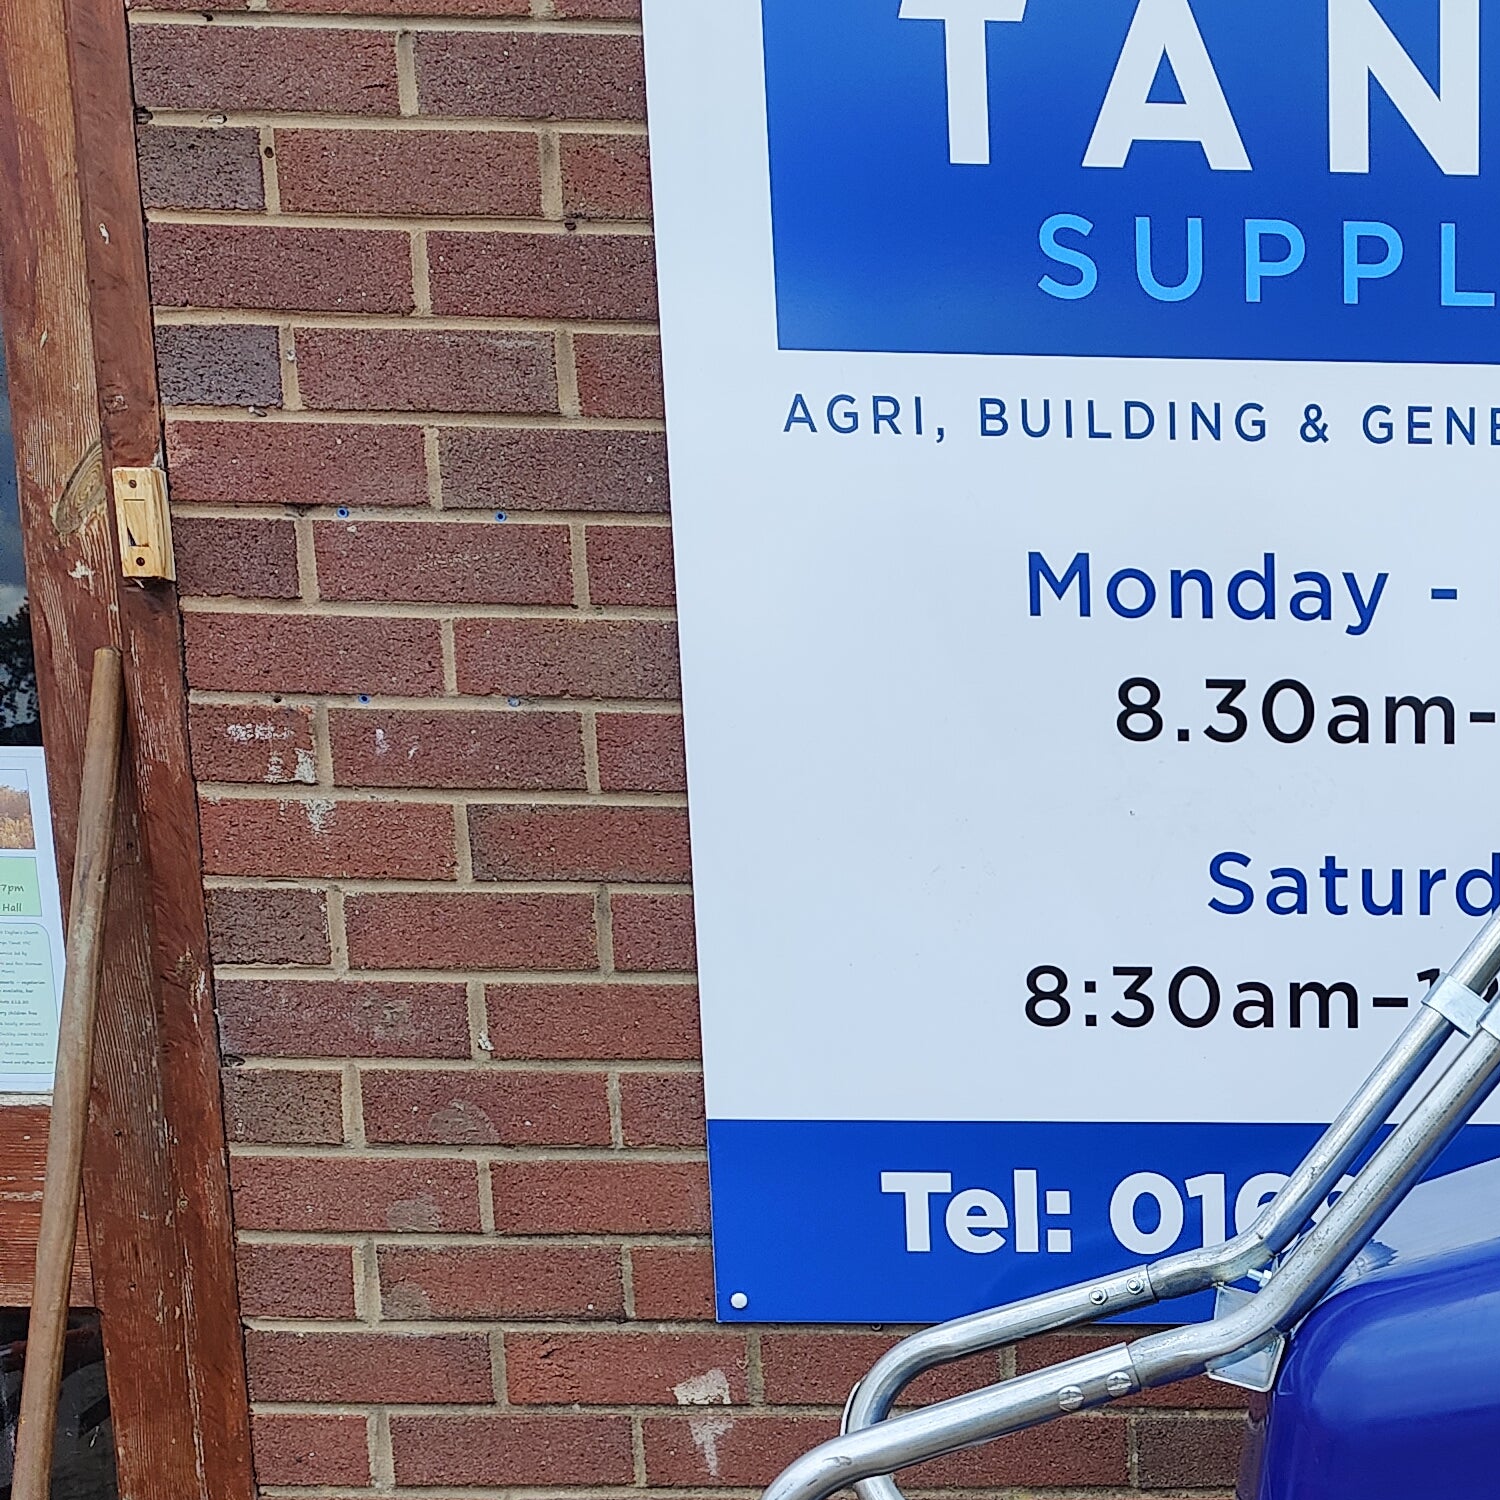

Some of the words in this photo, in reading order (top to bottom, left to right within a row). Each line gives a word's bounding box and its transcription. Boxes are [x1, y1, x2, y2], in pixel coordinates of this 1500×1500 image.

[783, 393, 946, 443] AGRI,
[979, 397, 1267, 442] BUILDING
[1299, 403, 1330, 443] &
[1027, 551, 1390, 636] Monday
[1430, 587, 1458, 601] -
[3, 902, 22, 913] Hall
[880, 1168, 1072, 1254] Tel:
